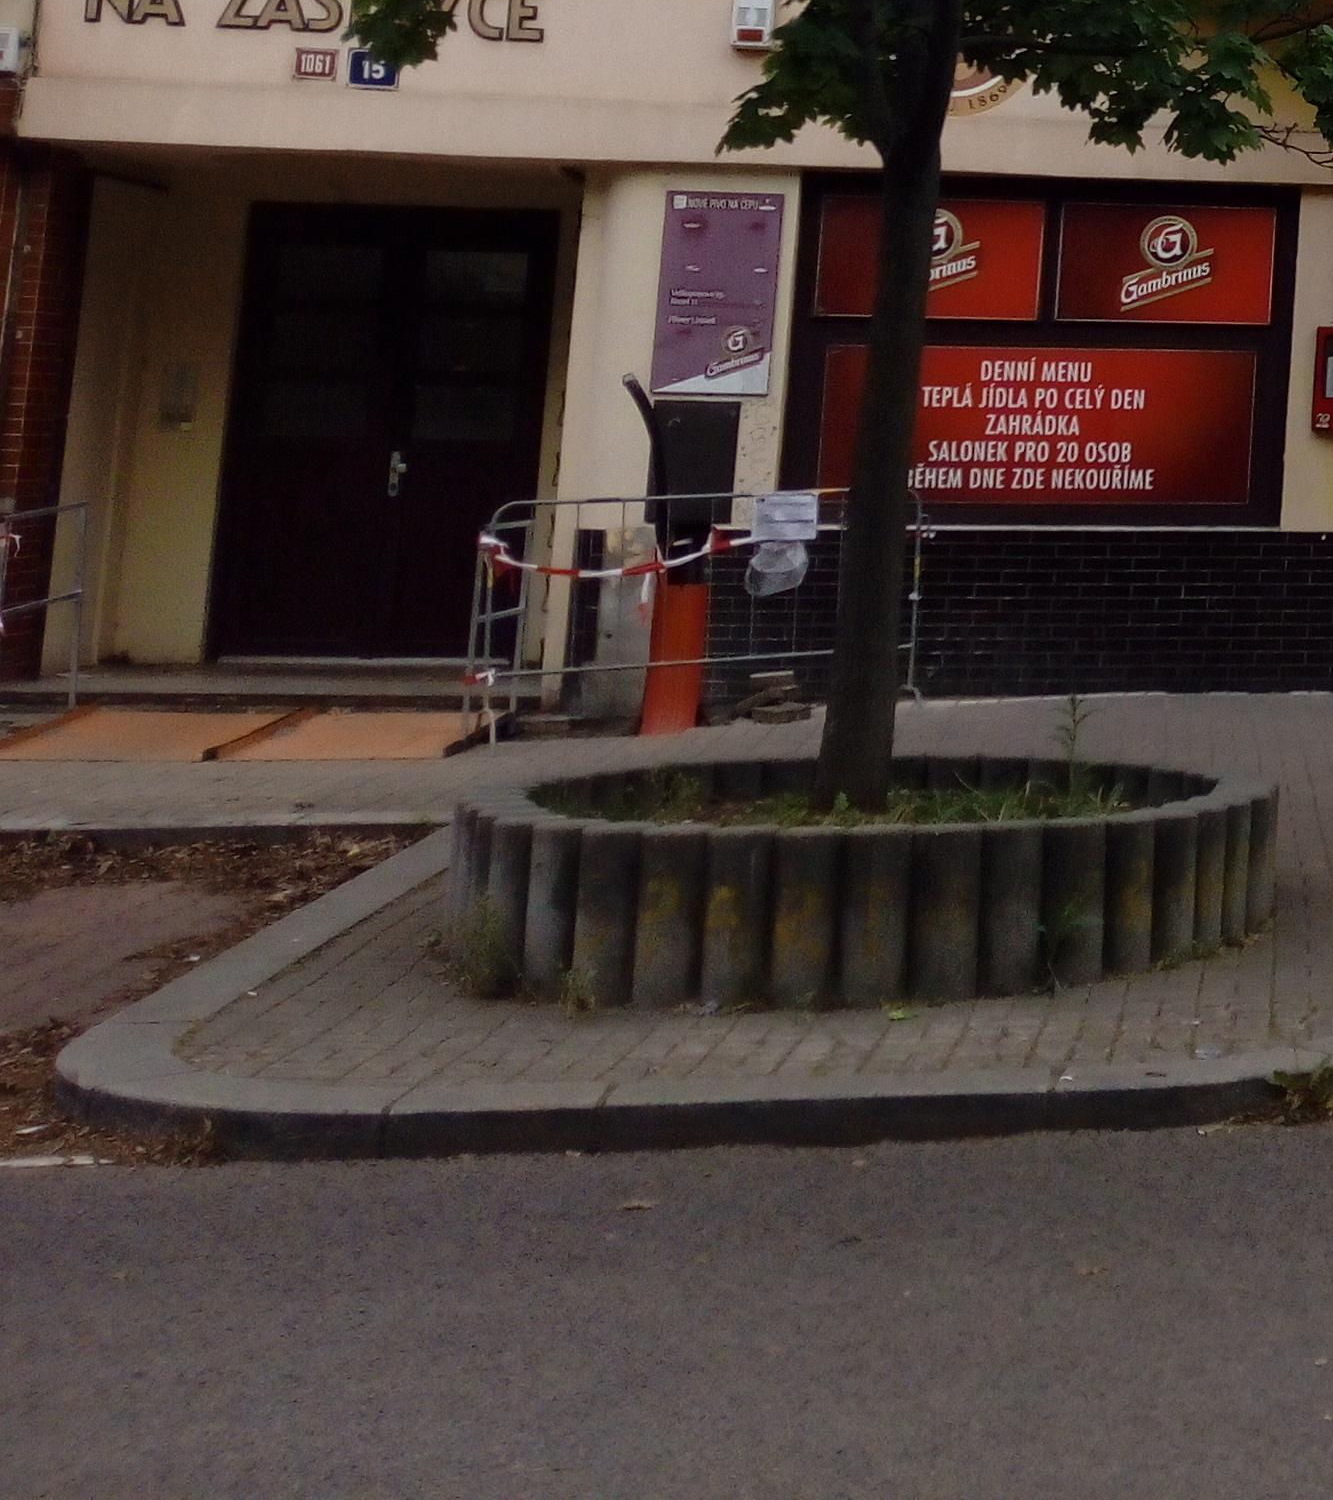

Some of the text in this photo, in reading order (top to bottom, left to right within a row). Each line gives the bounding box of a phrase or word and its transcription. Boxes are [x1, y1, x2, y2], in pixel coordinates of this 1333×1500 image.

[300, 52, 331, 74] 1061
[361, 59, 386, 81] 15
[928, 255, 977, 283] rinus
[1120, 261, 1211, 305] Gambrinus
[980, 357, 1093, 383] DENNÍ MENU
[922, 383, 1146, 410] TEPLÁ JÍDLA PO CELÝ DEN
[984, 411, 1081, 436] ZAHRÁDKA
[928, 440, 1132, 464] SALONEK PRO 20 OSOB
[969, 467, 1006, 490] DNE
[1010, 468, 1045, 490] ZDE
[1051, 464, 1155, 490] NEKOUŘÍME
